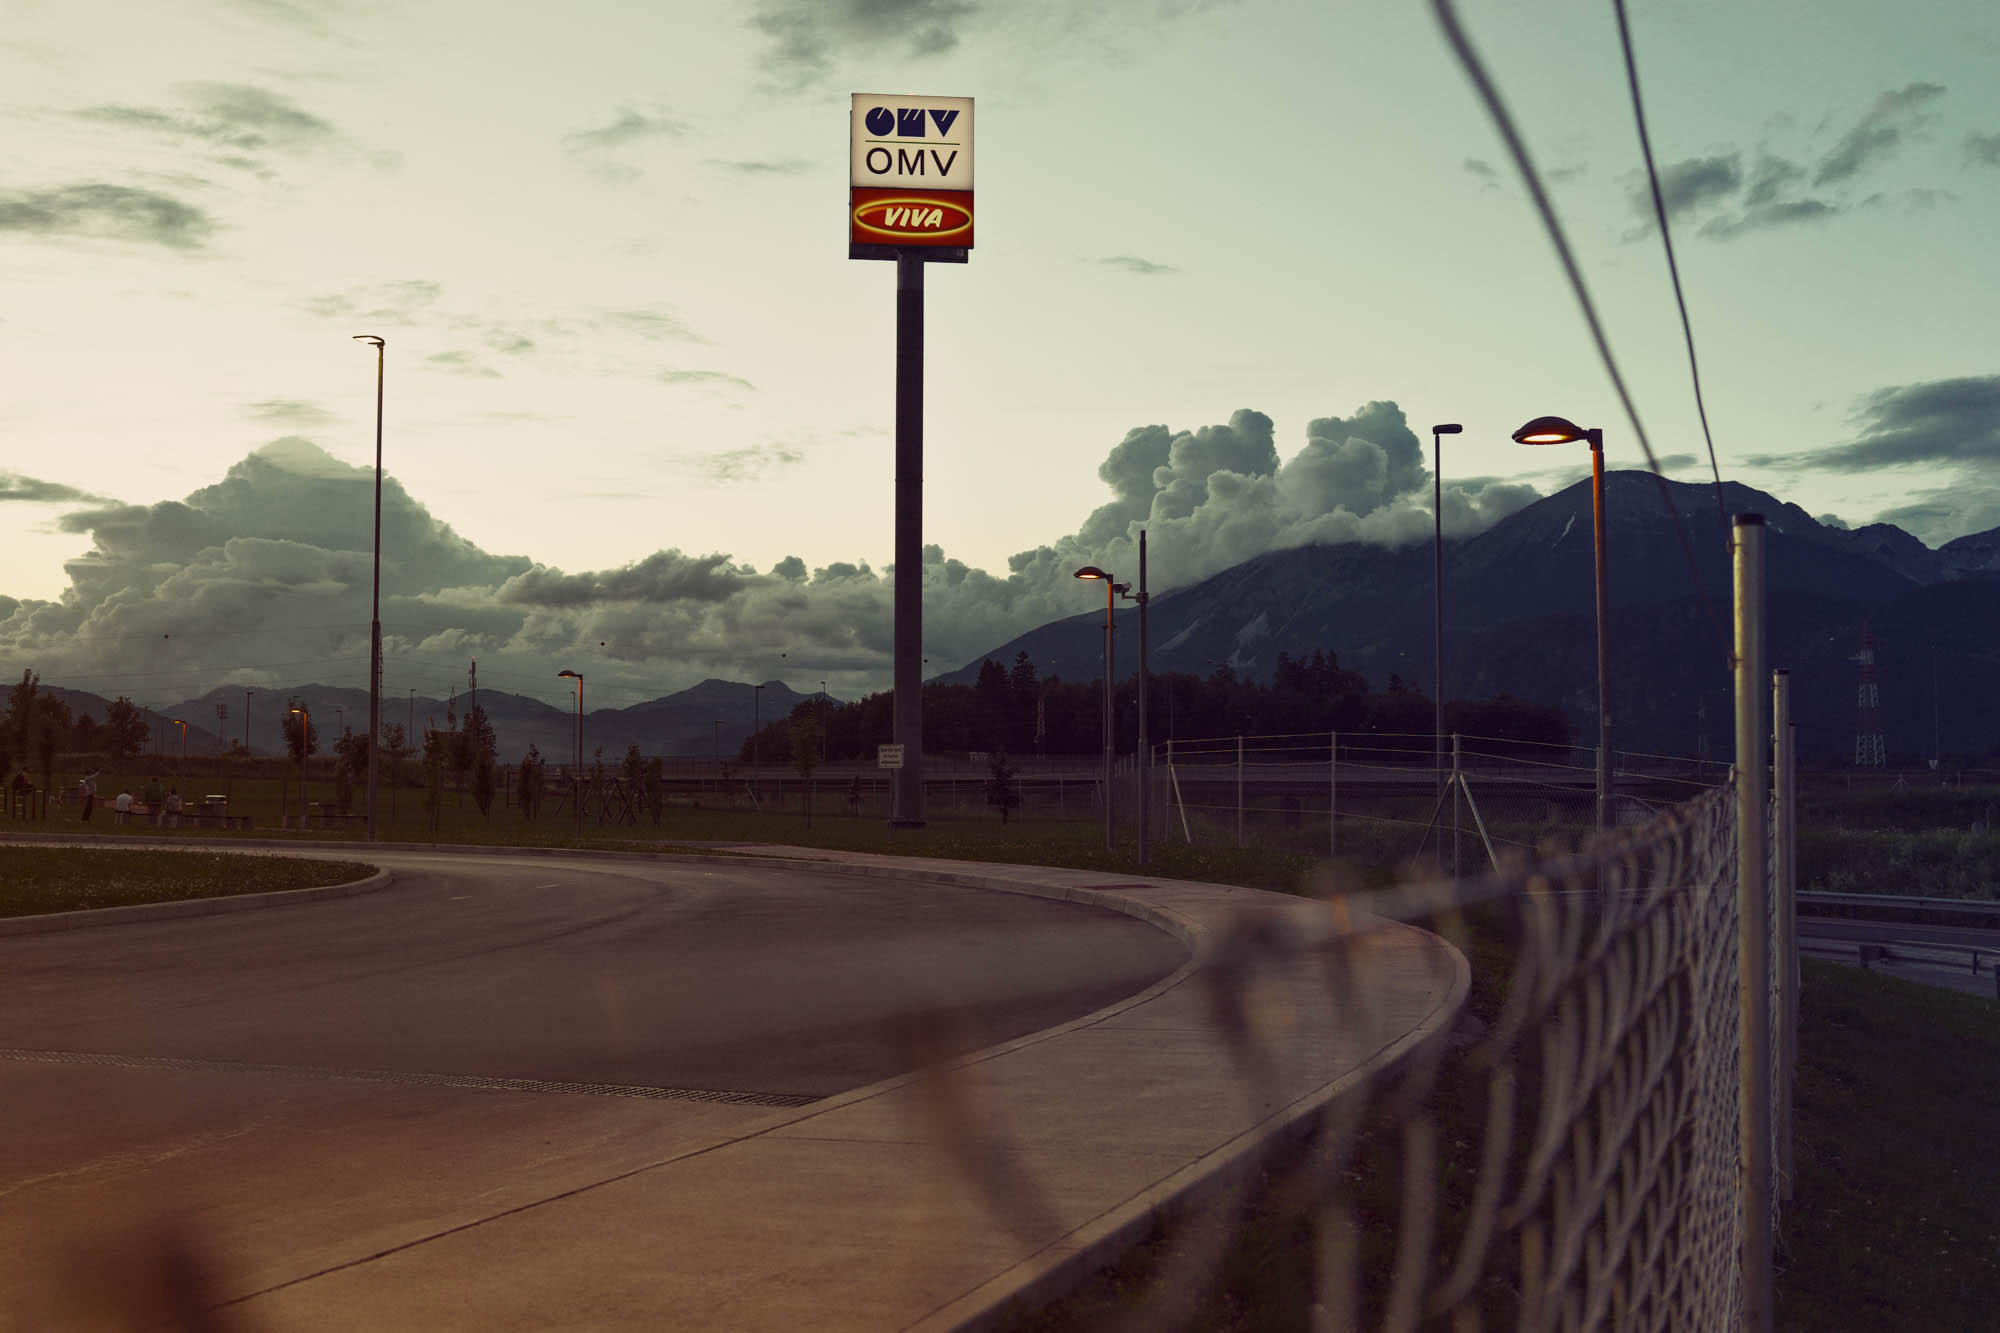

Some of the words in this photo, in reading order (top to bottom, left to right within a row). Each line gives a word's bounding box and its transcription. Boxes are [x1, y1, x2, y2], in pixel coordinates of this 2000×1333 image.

[865, 106, 960, 137] OMV
[866, 147, 958, 176] OMV
[884, 207, 943, 228] VIVA
